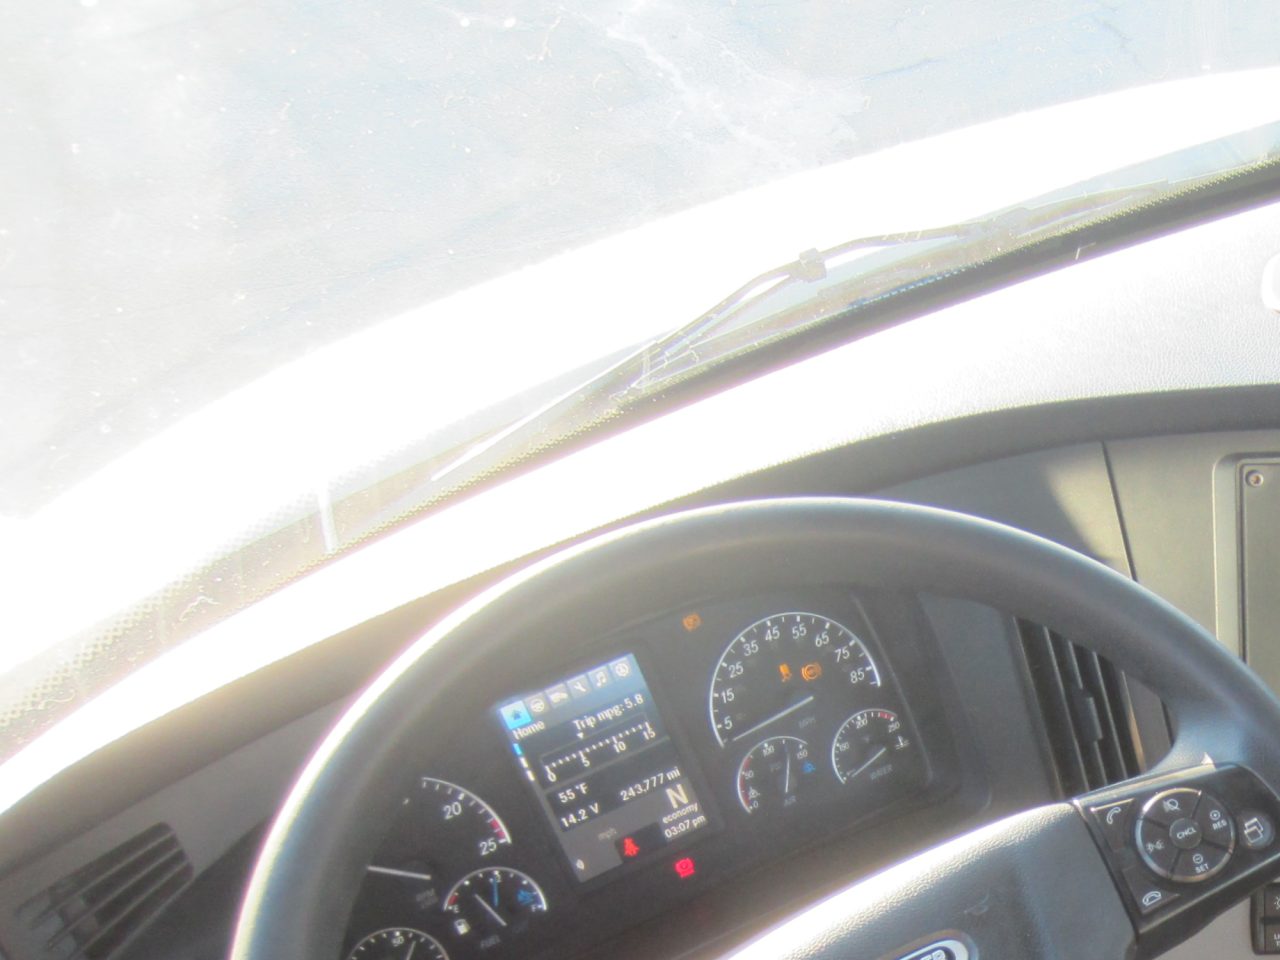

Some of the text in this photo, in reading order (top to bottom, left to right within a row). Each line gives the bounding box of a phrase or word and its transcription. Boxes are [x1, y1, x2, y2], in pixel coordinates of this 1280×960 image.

[765, 627, 780, 642] 45
[792, 624, 807, 640] 55
[743, 641, 759, 656] 35
[815, 633, 830, 648] 65
[835, 649, 850, 663] 75
[728, 662, 744, 679] 25
[850, 669, 865, 684] 85
[721, 691, 735, 703] 15
[573, 713, 597, 732] Trip
[623, 693, 645, 710] 5.8
[512, 719, 547, 741] Home
[724, 718, 733, 731] 5
[643, 728, 656, 741] 15
[613, 741, 627, 754] 10
[582, 756, 591, 768] 5
[548, 770, 557, 783] 0
[666, 766, 682, 782] mi
[558, 788, 576, 804] 55
[665, 783, 689, 809] N
[443, 802, 462, 820] 20
[561, 802, 600, 828] 14.2 V
[662, 802, 700, 824] economy
[664, 813, 707, 839] 03:07 pm
[479, 839, 497, 856] 25
